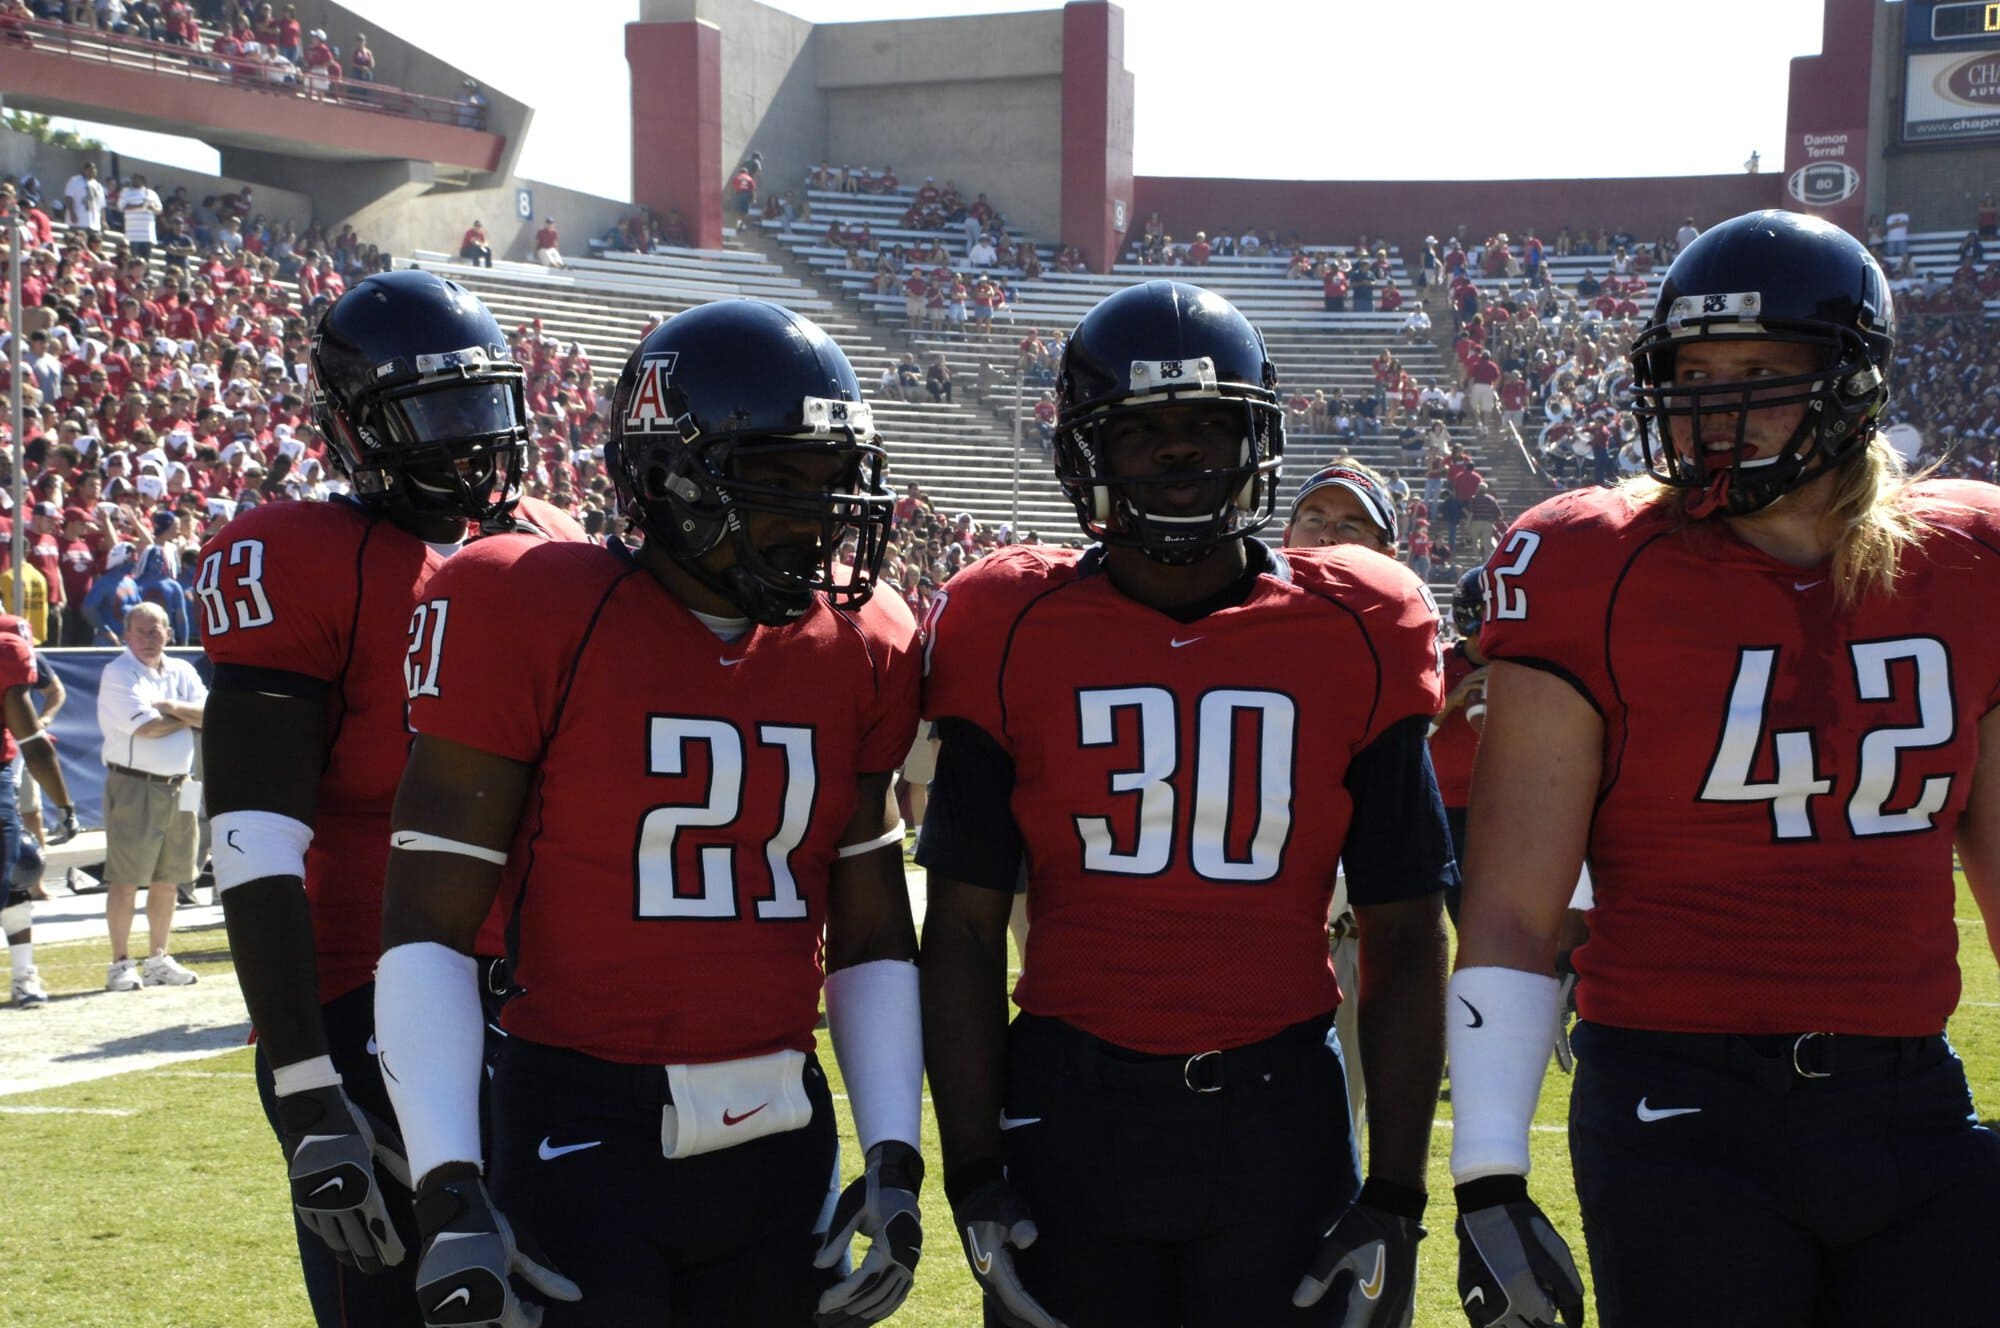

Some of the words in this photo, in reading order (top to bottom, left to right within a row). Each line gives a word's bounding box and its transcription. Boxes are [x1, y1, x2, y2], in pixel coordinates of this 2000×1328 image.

[1804, 134, 1848, 146] Damon
[1806, 144, 1845, 158] Terrell
[519, 191, 530, 217] 8
[1816, 178, 1833, 190] 80
[1116, 205, 1124, 227] 9
[376, 362, 394, 378] NIKE
[623, 352, 679, 435] A
[195, 538, 275, 637] 83
[403, 598, 450, 700] 21
[1694, 634, 1957, 842] 42
[1071, 683, 1299, 885] 30
[632, 712, 820, 921] 21
